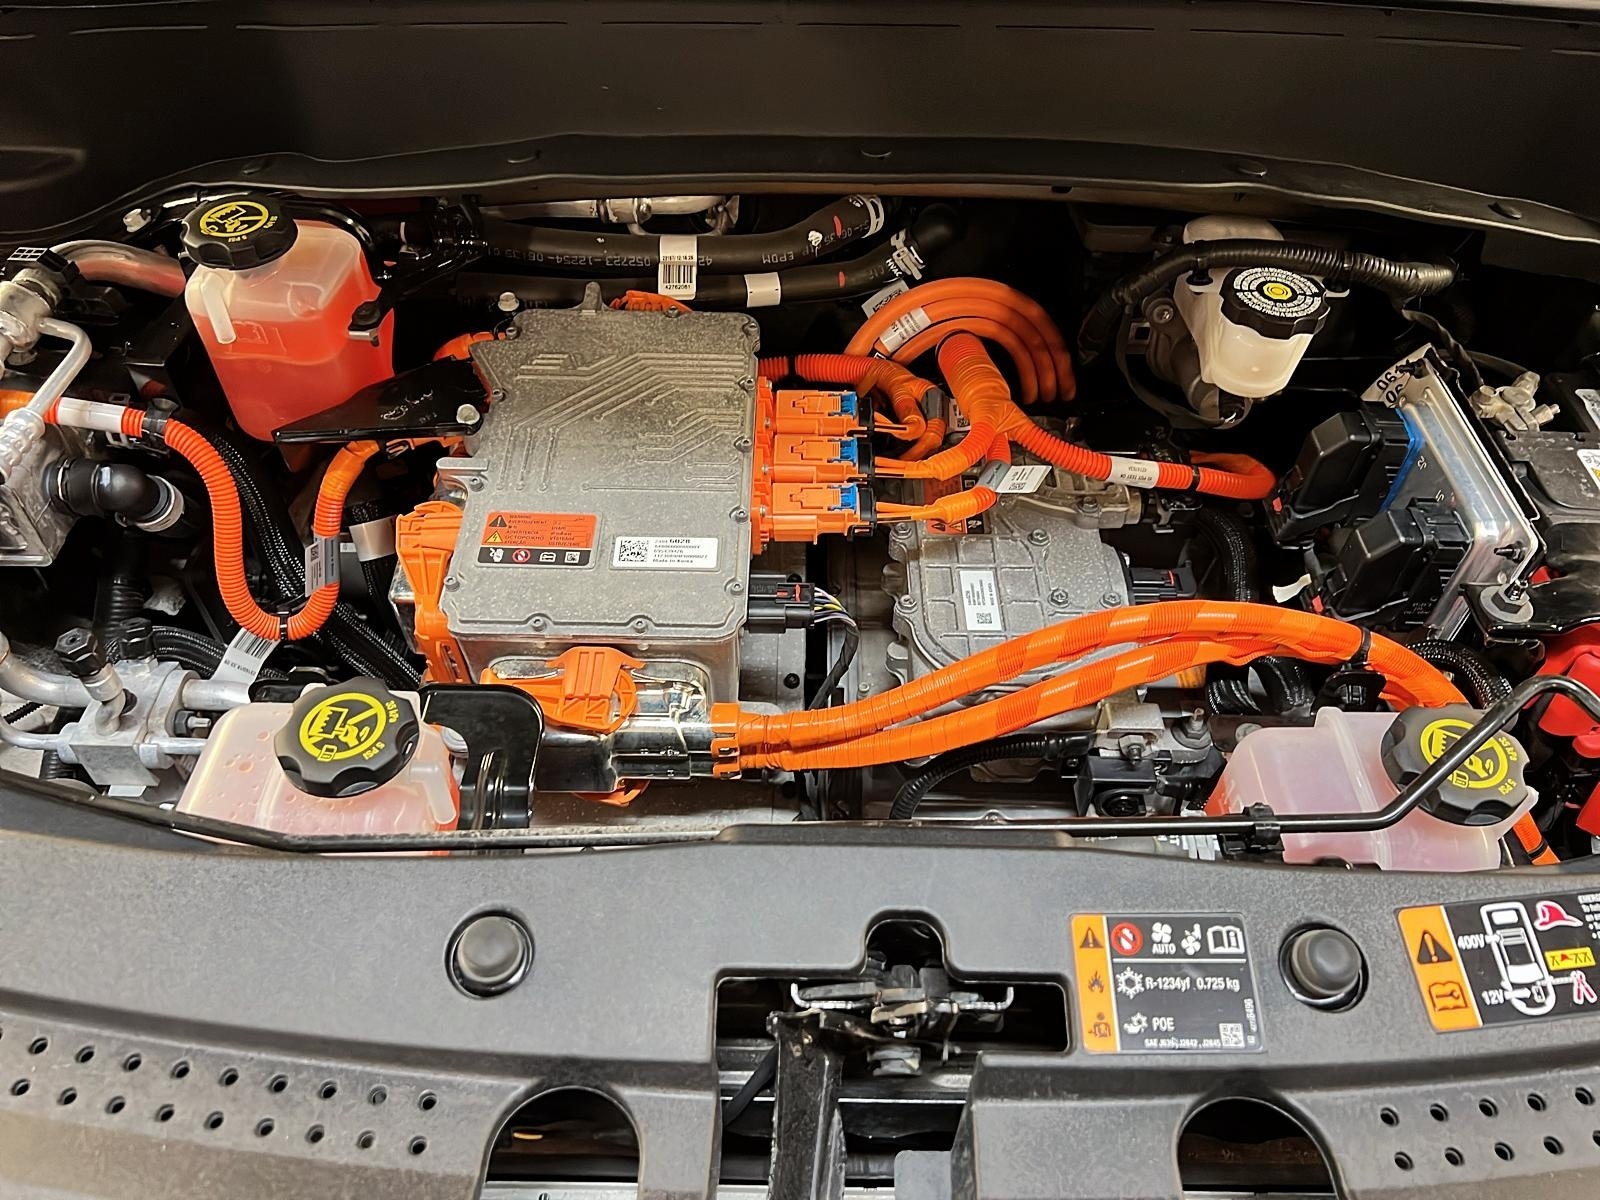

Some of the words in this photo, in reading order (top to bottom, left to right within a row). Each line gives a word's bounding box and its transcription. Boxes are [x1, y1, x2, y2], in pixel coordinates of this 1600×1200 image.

[762, 251, 794, 264] EPDM
[886, 258, 903, 277] HVAC
[376, 741, 386, 750] 5
[362, 746, 380, 760] PSI
[1457, 933, 1486, 950] 400V
[1152, 943, 1176, 955] AUTO
[1196, 976, 1225, 989] 0.725
[1226, 977, 1241, 992] kg
[1481, 989, 1504, 1006] 12V
[1152, 1016, 1175, 1031] POE
[1144, 1038, 1158, 1048] SAE
